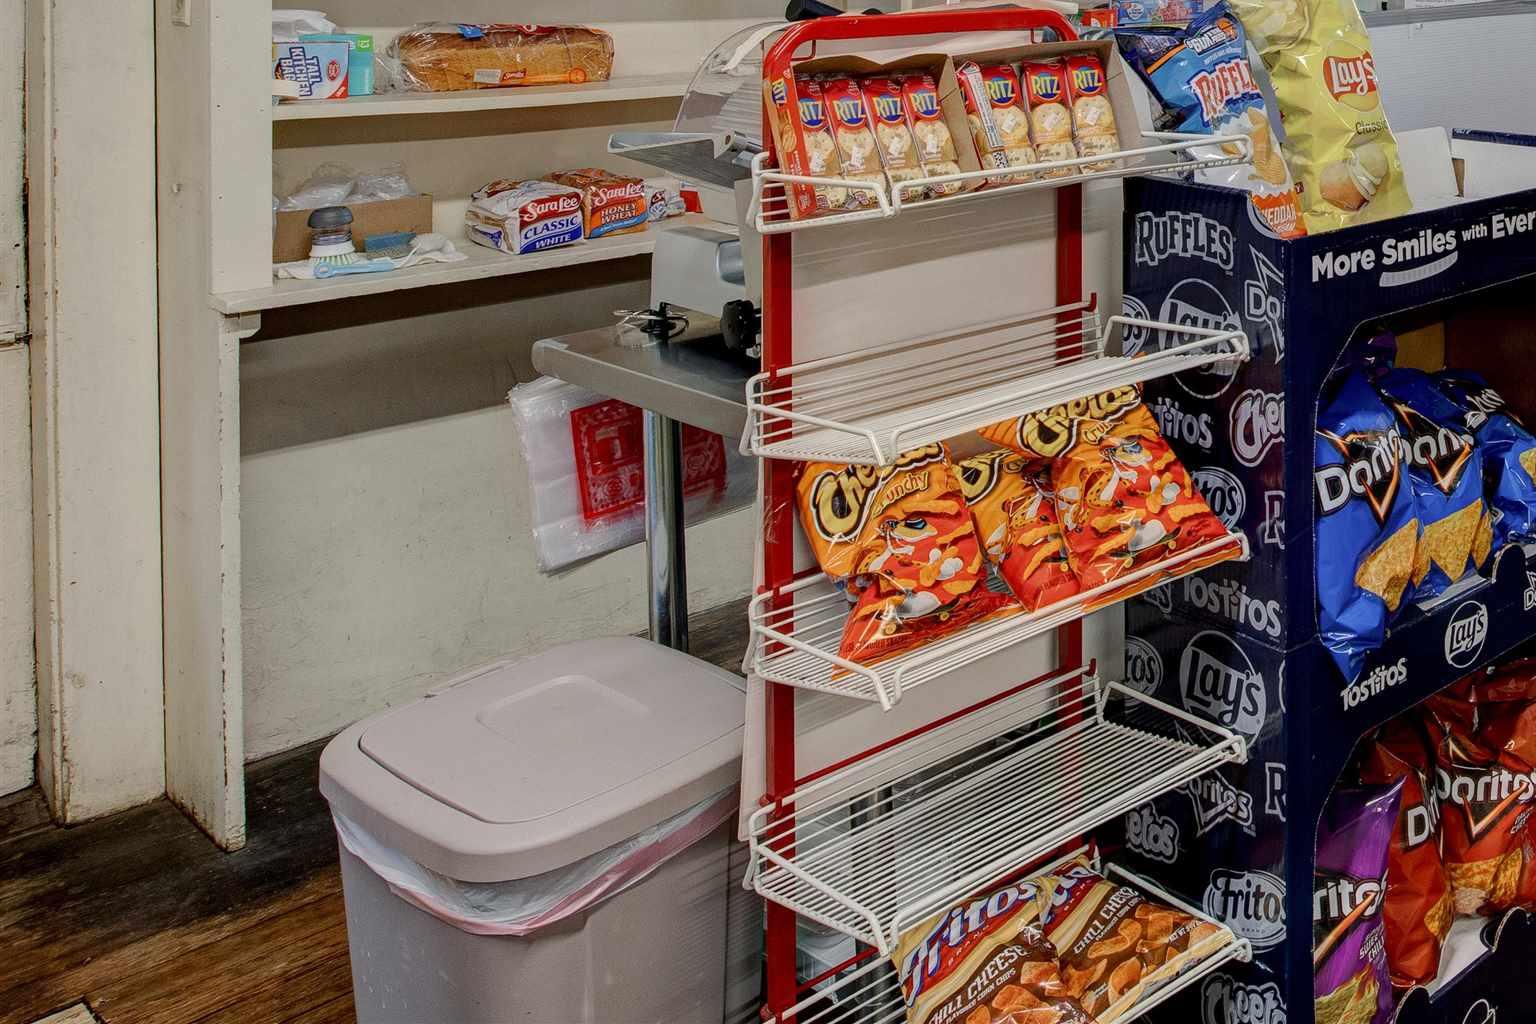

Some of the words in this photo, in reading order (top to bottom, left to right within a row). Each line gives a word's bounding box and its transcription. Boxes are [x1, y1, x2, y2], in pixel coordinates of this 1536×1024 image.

[281, 59, 296, 81] BAG
[291, 47, 311, 96] KITCHEN
[306, 57, 322, 84] TALL
[1072, 68, 1103, 89] RITZ
[1330, 51, 1378, 97] Lay's
[985, 79, 1016, 99] RITZ
[1031, 74, 1062, 94] RITZ
[833, 99, 867, 121] RITZ
[872, 95, 905, 117] RITZ
[909, 91, 941, 112] RITZ
[522, 201, 558, 222] Sara
[558, 196, 581, 213] Lee
[600, 202, 638, 217] HONEY
[600, 209, 639, 225] WHEAT
[524, 215, 579, 241] CLASSIC
[535, 233, 572, 249] WHITE
[1134, 211, 1236, 270] RUFFLES
[1311, 247, 1376, 282] More
[1381, 228, 1456, 266] Smiles
[1461, 223, 1488, 243] with
[1451, 611, 1487, 650] Lay's
[1184, 645, 1261, 728] Lay's
[901, 879, 1041, 1007] Fritos
[967, 944, 1028, 1000] CHEESE
